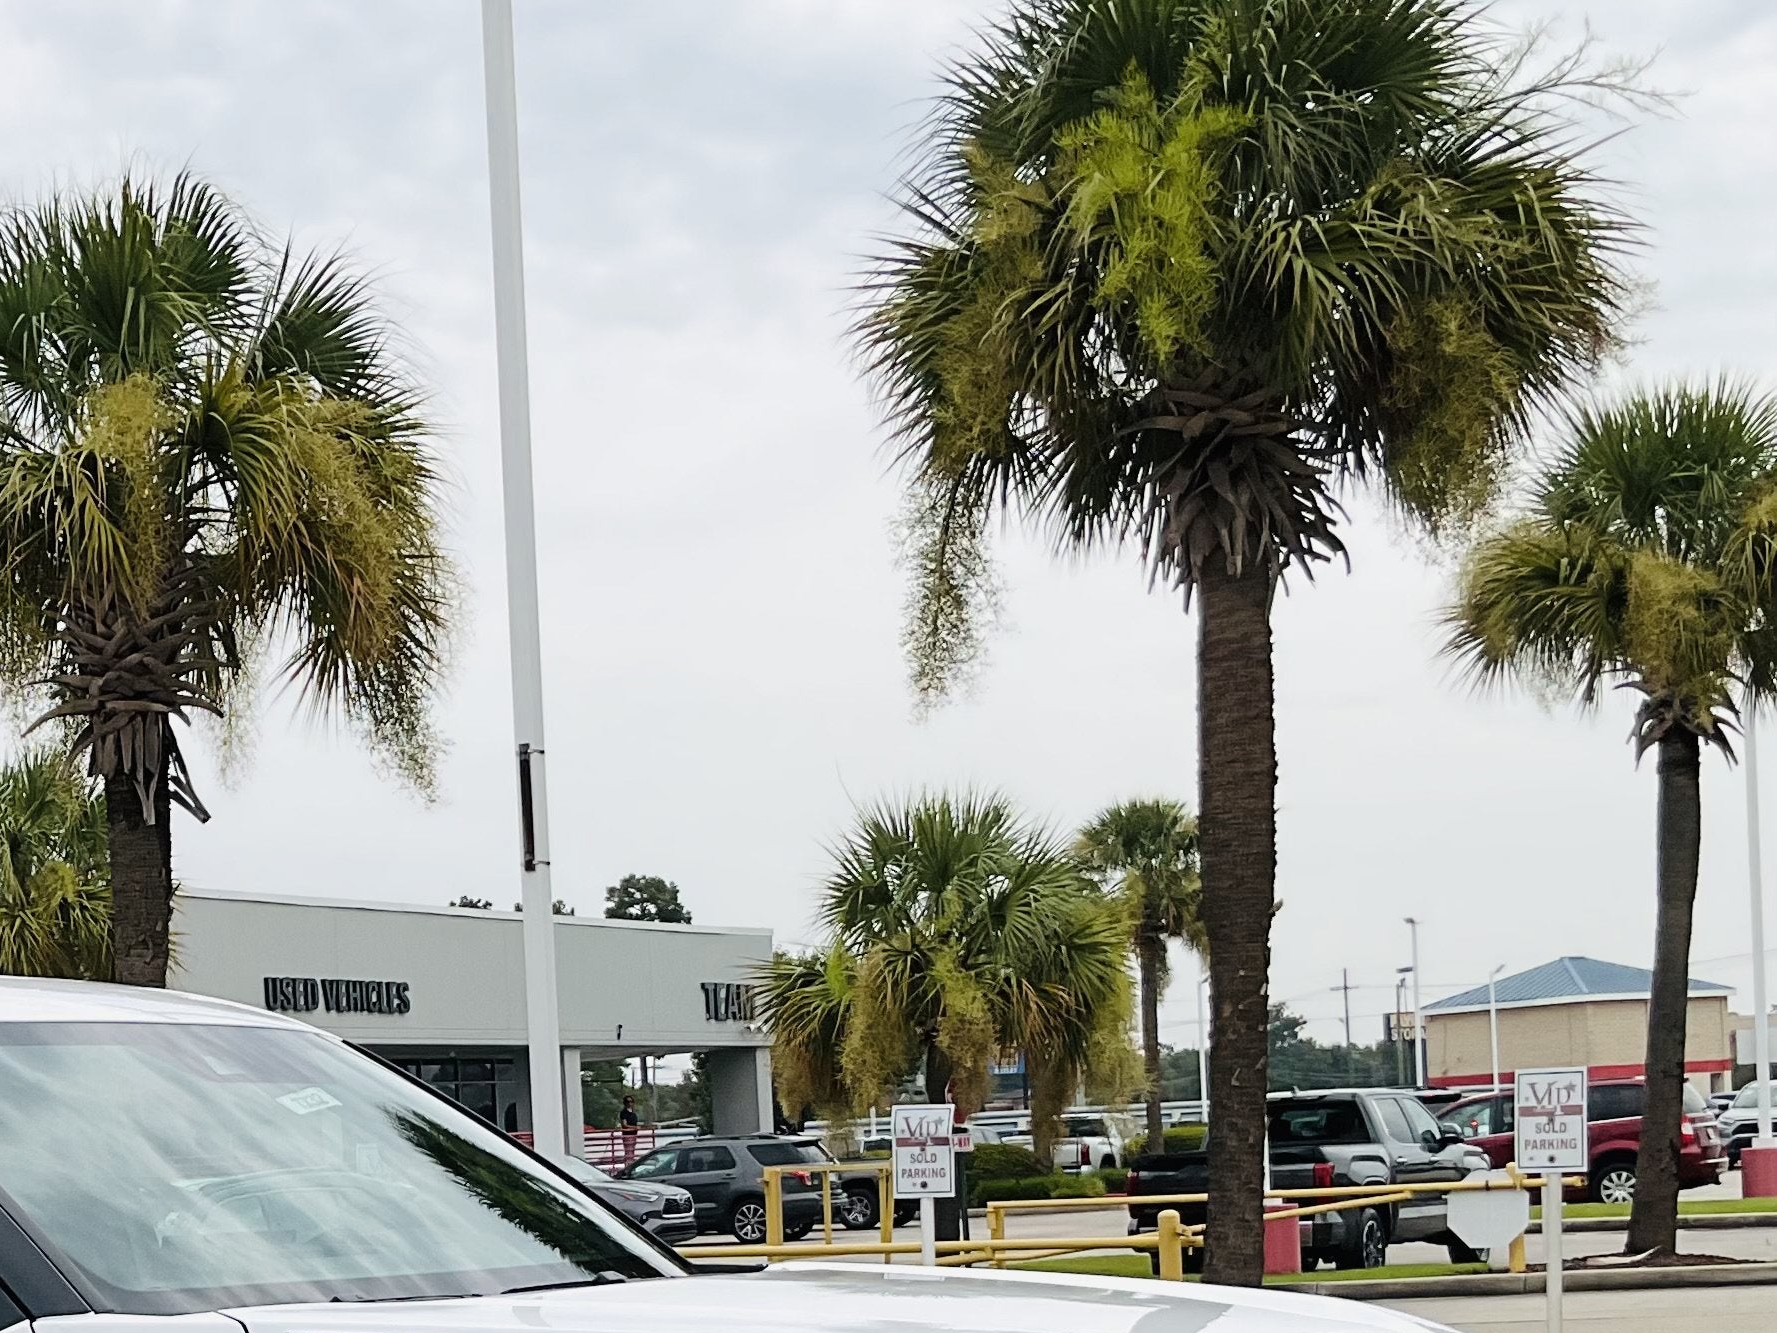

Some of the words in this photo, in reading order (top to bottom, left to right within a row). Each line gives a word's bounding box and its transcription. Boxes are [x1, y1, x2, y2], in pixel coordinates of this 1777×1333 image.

[264, 977, 319, 1011] USED
[321, 979, 410, 1013] VEHICLES
[1535, 1122, 1567, 1134] SOLD
[1525, 1138, 1577, 1150] PARKING
[910, 1153, 937, 1163] SOLD
[901, 1168, 946, 1179] PARKING
